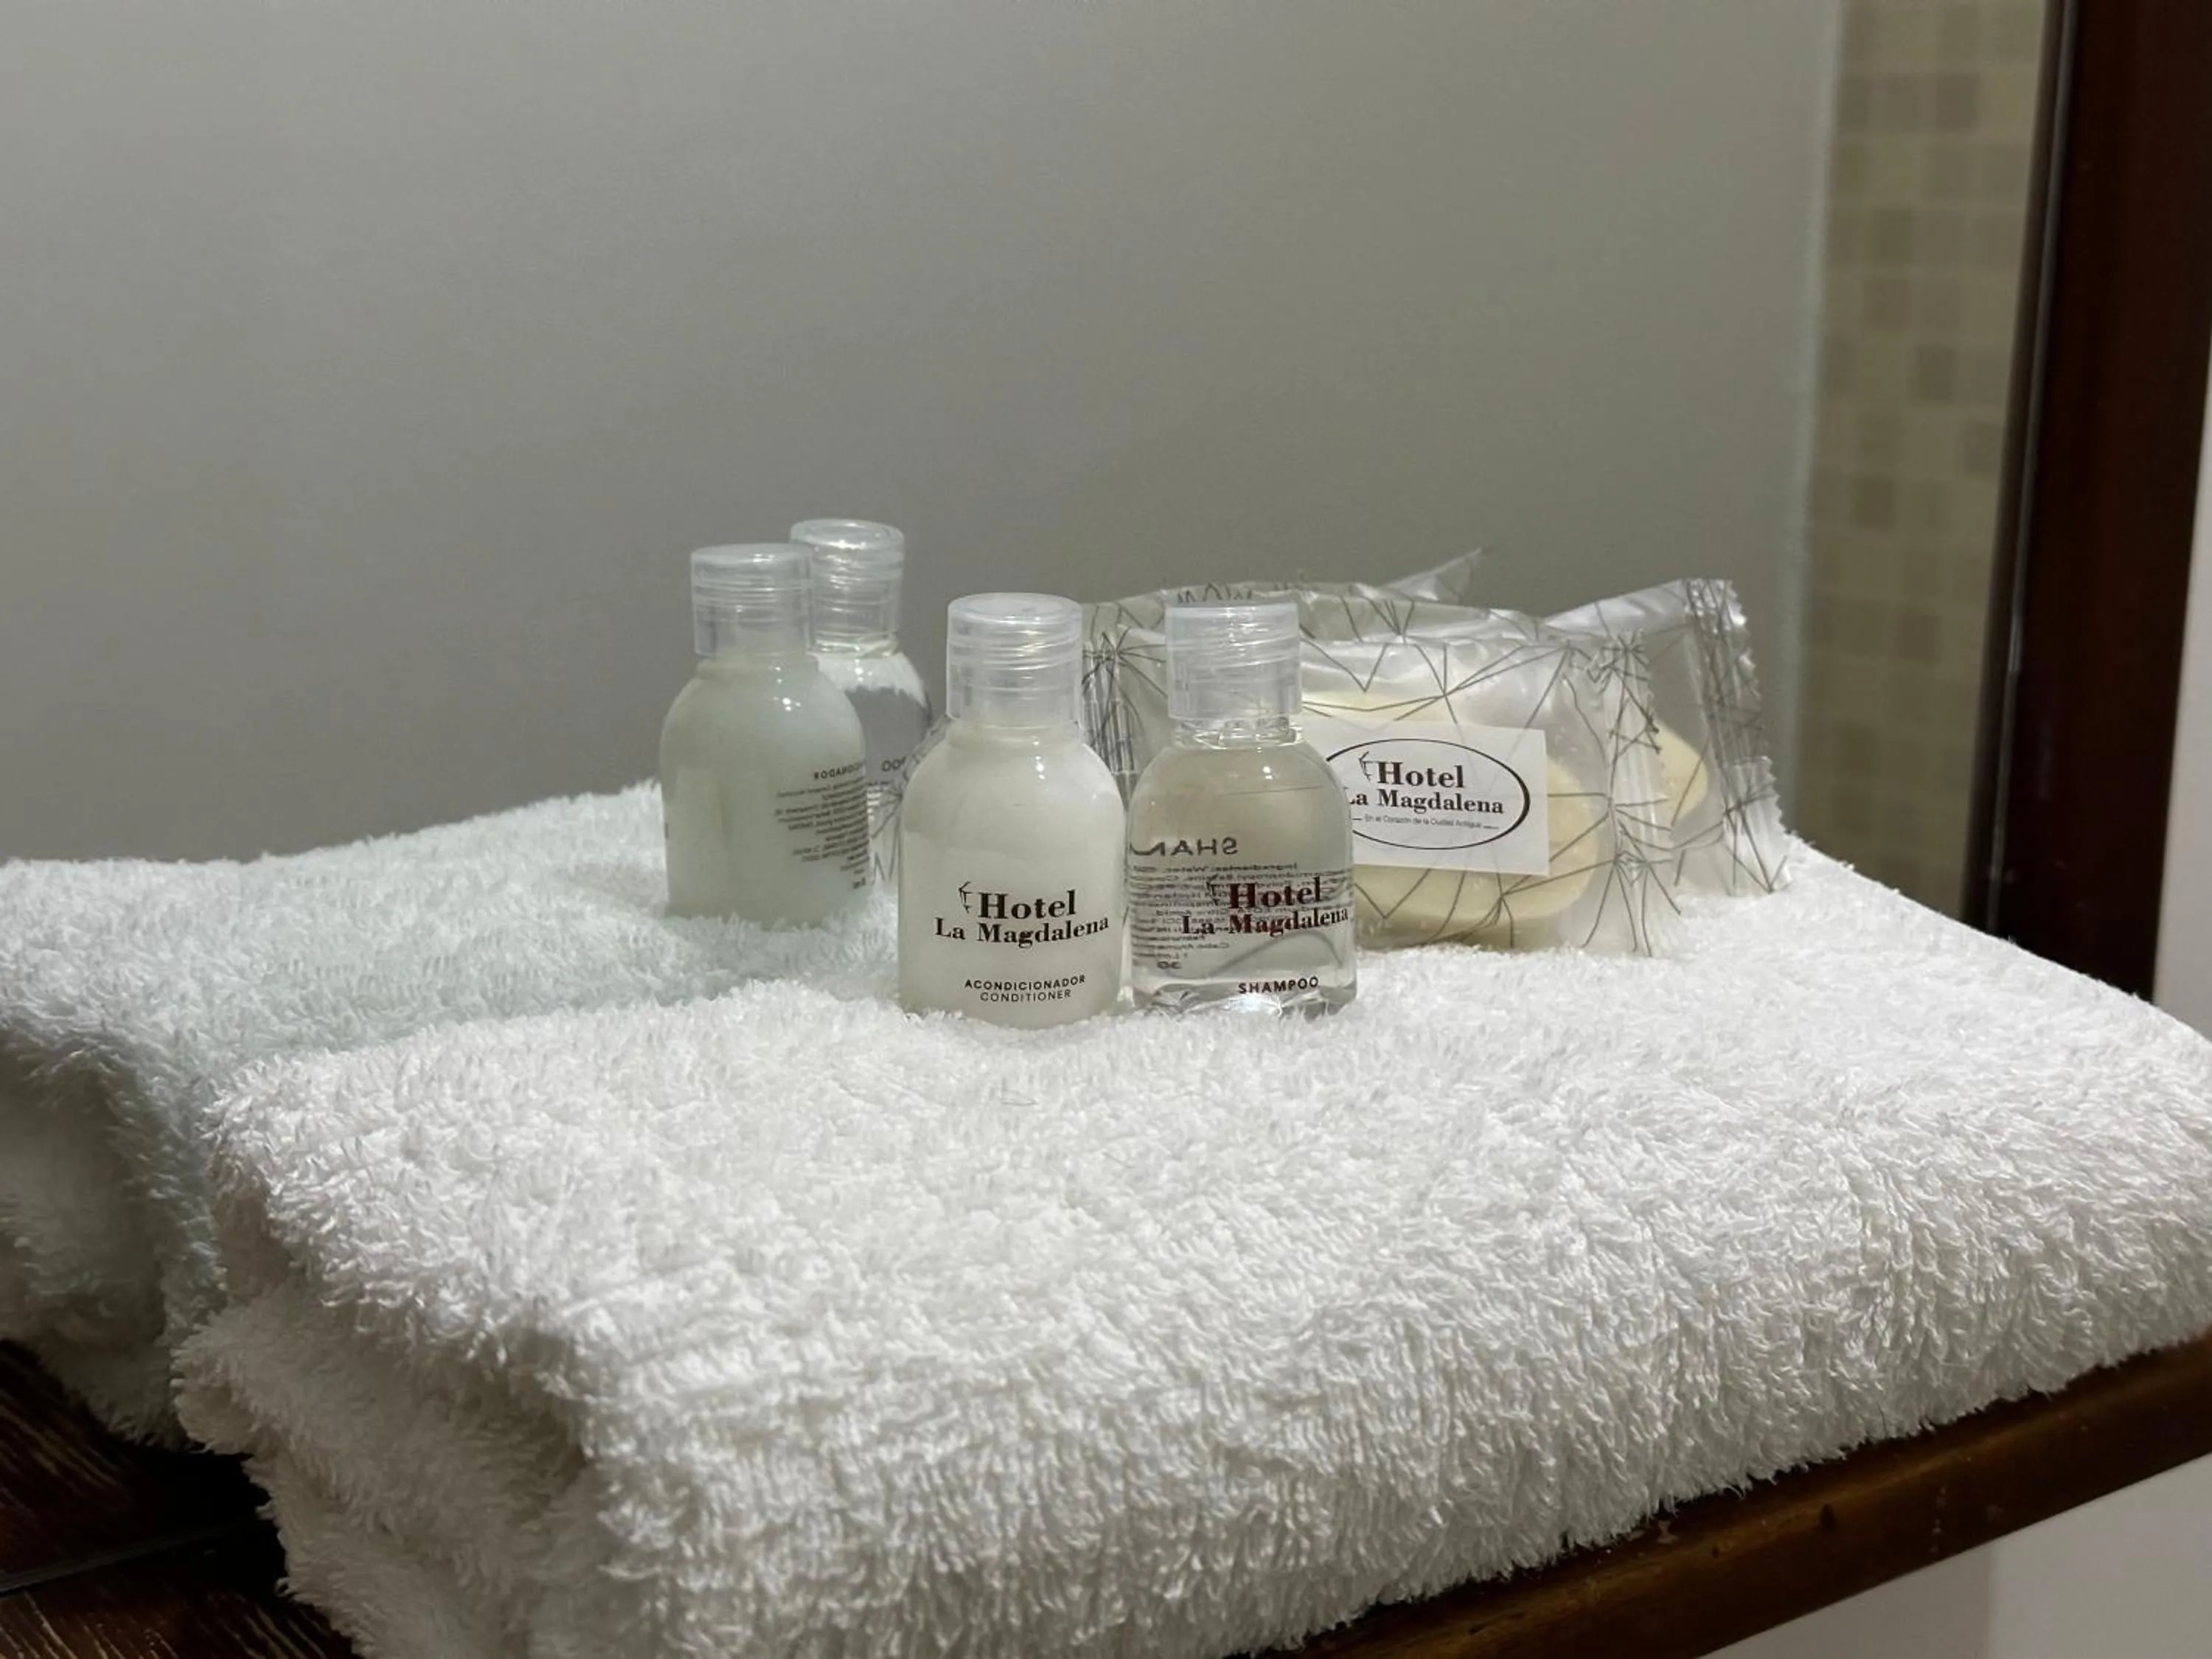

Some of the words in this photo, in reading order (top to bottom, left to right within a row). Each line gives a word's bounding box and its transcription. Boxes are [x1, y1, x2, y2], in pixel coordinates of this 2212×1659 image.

[1377, 761, 1465, 788] Hotel
[1377, 788, 1504, 814] Magdalena
[978, 888, 1077, 920] Hotel
[1227, 876, 1322, 910] Hotel
[933, 917, 966, 940] La
[976, 917, 1110, 948] Magdalena
[1180, 914, 1217, 935] La
[1227, 907, 1349, 938] Magdalena
[964, 974, 1086, 991] ACONDICIONADOR
[979, 989, 1071, 1003] CONDITIONER
[1237, 975, 1320, 995] SHAMPOO
